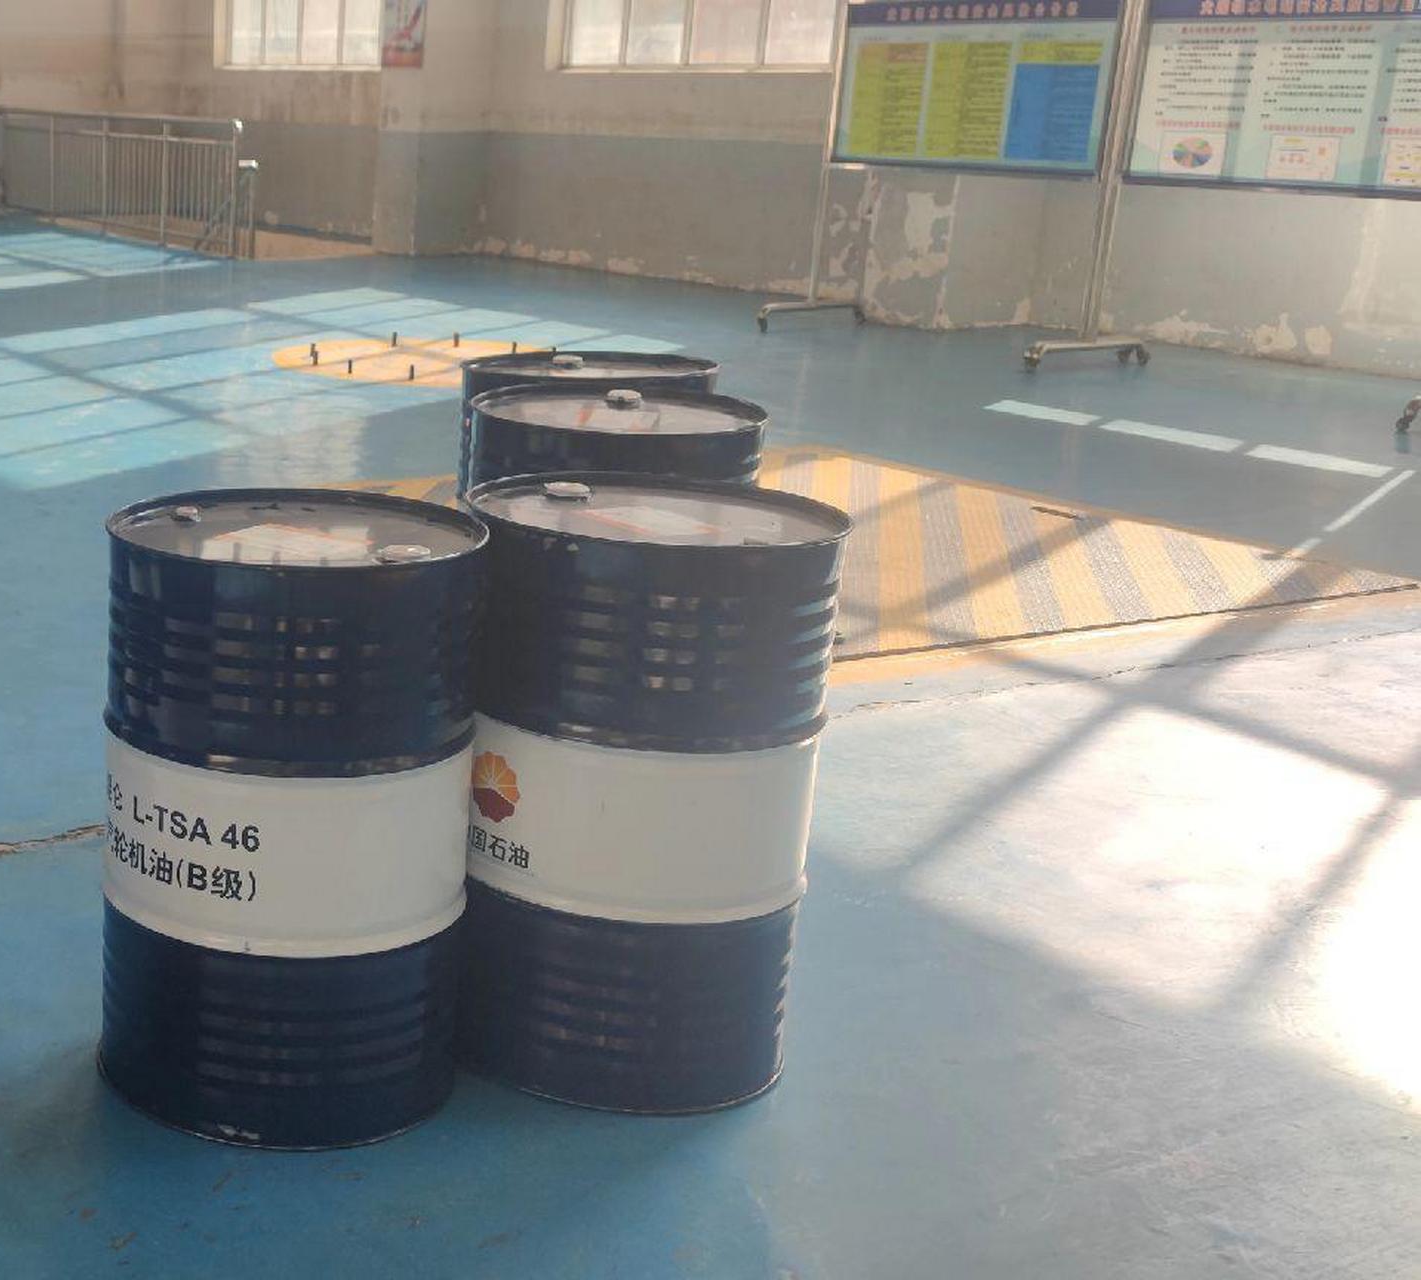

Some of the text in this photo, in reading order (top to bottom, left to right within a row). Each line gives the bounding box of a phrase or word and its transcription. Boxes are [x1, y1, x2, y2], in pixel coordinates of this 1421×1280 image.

[133, 796, 212, 846] L-TSA
[221, 824, 260, 852] 46
[468, 825, 530, 869] 国石油
